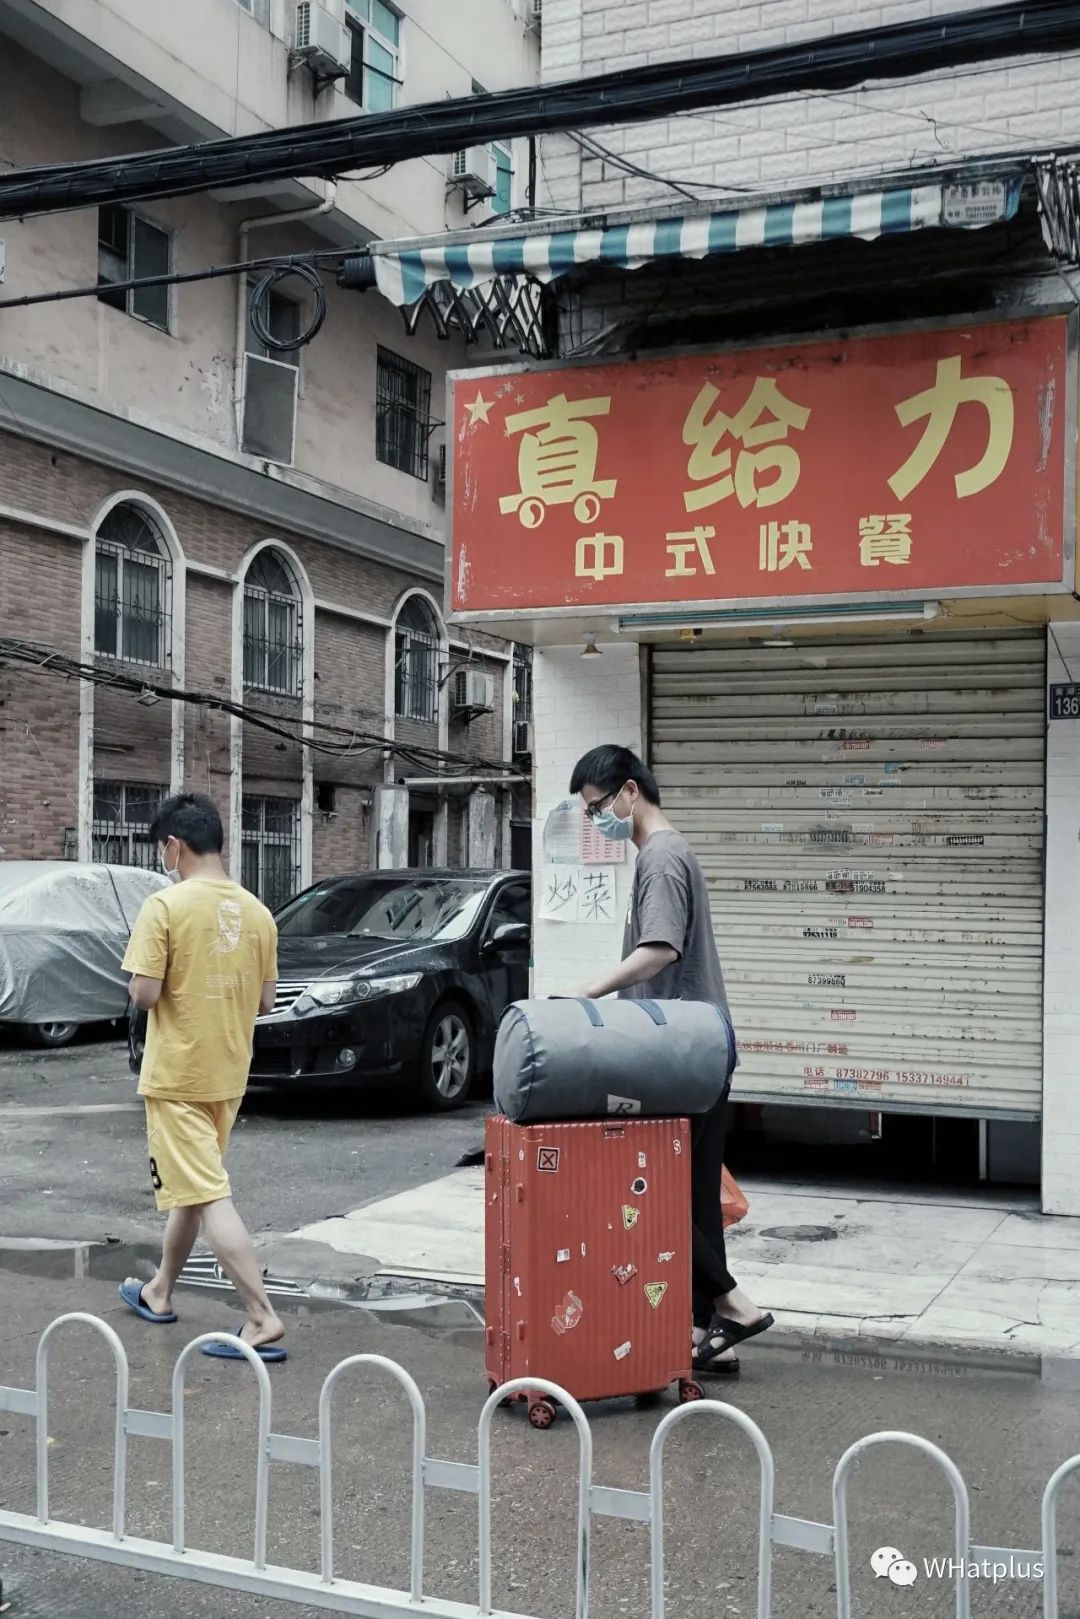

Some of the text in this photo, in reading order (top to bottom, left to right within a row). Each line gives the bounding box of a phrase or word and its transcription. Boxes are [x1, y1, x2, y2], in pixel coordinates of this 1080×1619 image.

[499, 356, 1014, 528] 真给力
[575, 513, 912, 581] 中式快餐
[545, 871, 611, 920] 炒菜
[804, 1066, 825, 1077] 电话
[836, 1068, 889, 1080] 87382796
